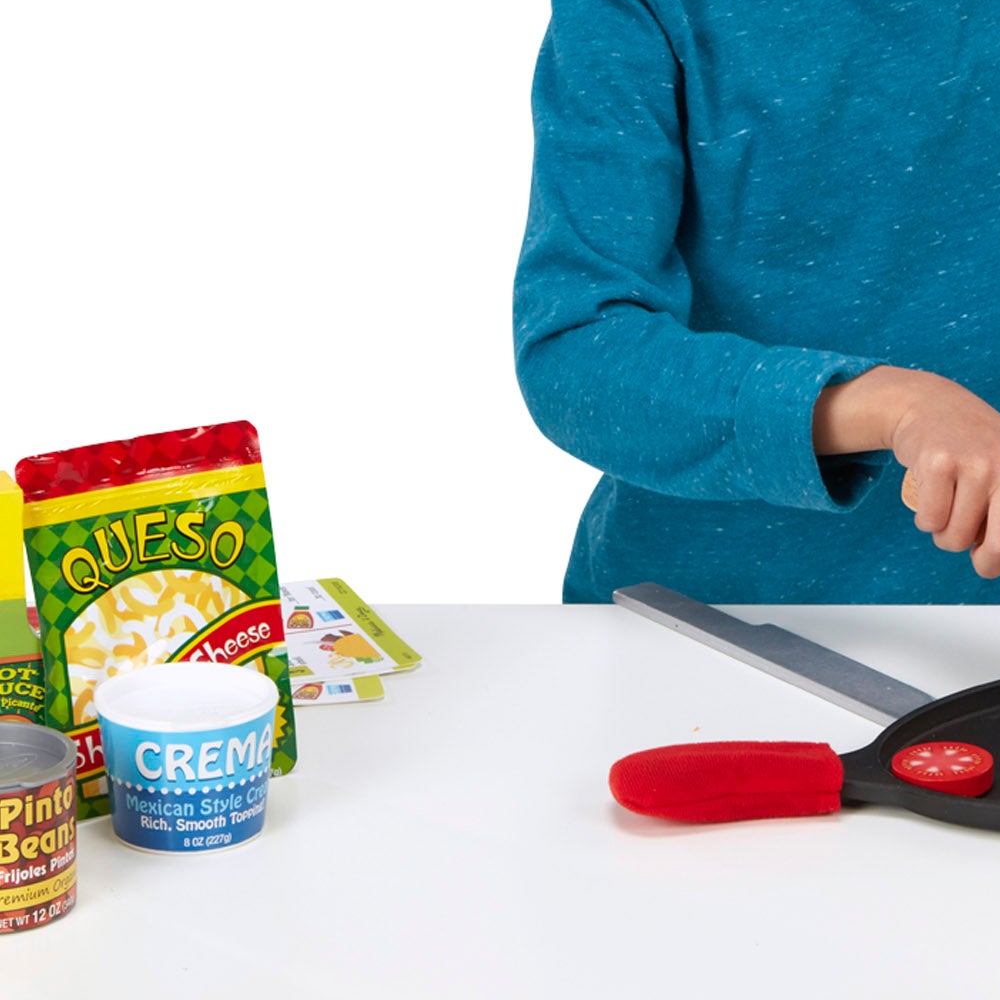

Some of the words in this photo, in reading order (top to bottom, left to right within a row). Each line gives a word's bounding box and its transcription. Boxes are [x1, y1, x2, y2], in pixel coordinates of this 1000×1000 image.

[60, 510, 247, 595] QUESO
[135, 723, 272, 783] CREMA
[0, 784, 73, 830] Pinto
[125, 792, 194, 816] Mexican
[200, 793, 242, 815] Style
[0, 816, 75, 865] Beans
[176, 815, 226, 831] Smooth
[183, 838, 191, 847] 8
[192, 837, 204, 846] OZ
[206, 833, 232, 847] (227g)
[16, 914, 30, 926] WT
[32, 908, 46, 923] 12
[49, 902, 61, 918] OZ
